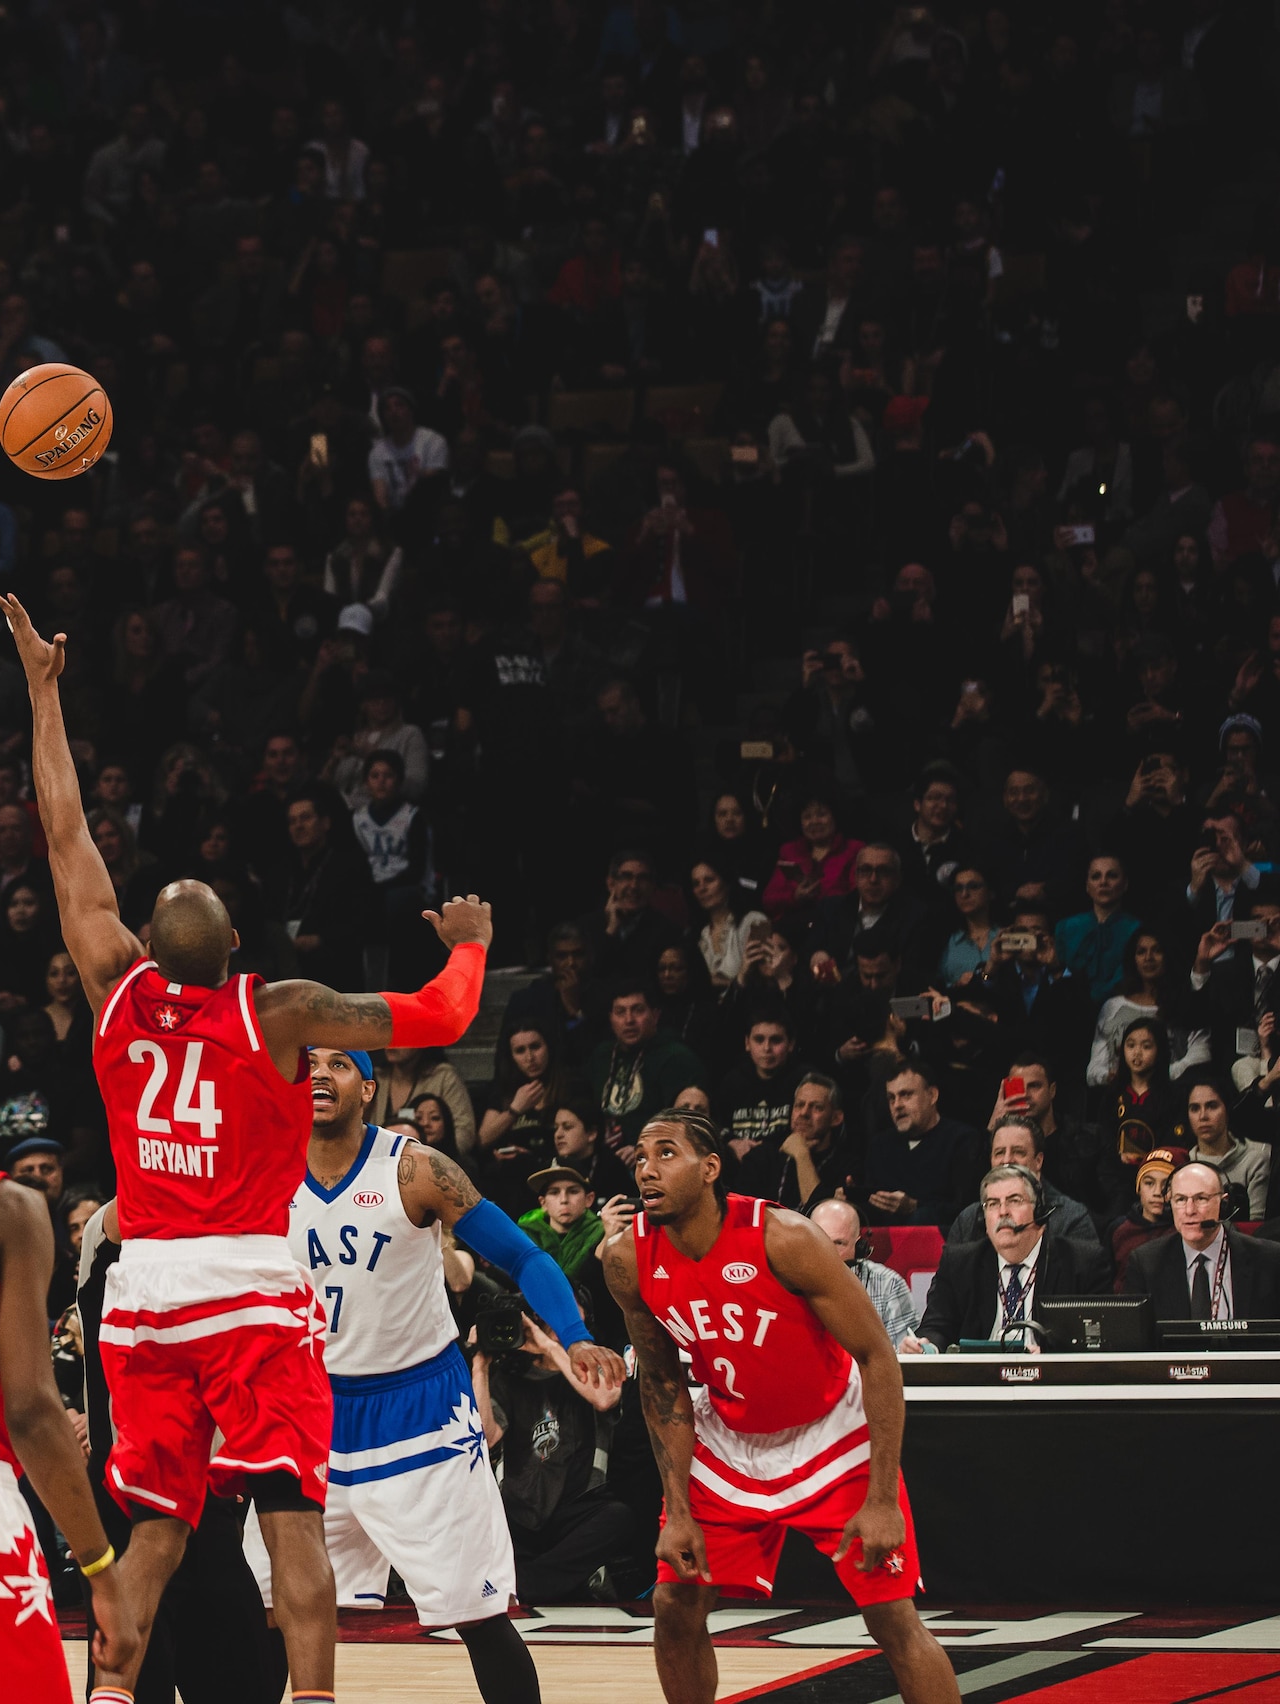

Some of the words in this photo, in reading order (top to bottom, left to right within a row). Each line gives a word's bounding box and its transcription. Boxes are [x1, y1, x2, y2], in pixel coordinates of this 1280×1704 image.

[35, 407, 101, 468] SPALDING
[128, 1039, 222, 1139] 24
[138, 1137, 219, 1178] BRYANT
[358, 1194, 379, 1204] KIA
[308, 1224, 392, 1272] AST
[728, 1266, 751, 1279] KIA
[325, 1286, 343, 1333] 7
[655, 1300, 778, 1347] WEST
[1200, 1321, 1248, 1331] SAMSUNG
[713, 1357, 745, 1400] 2
